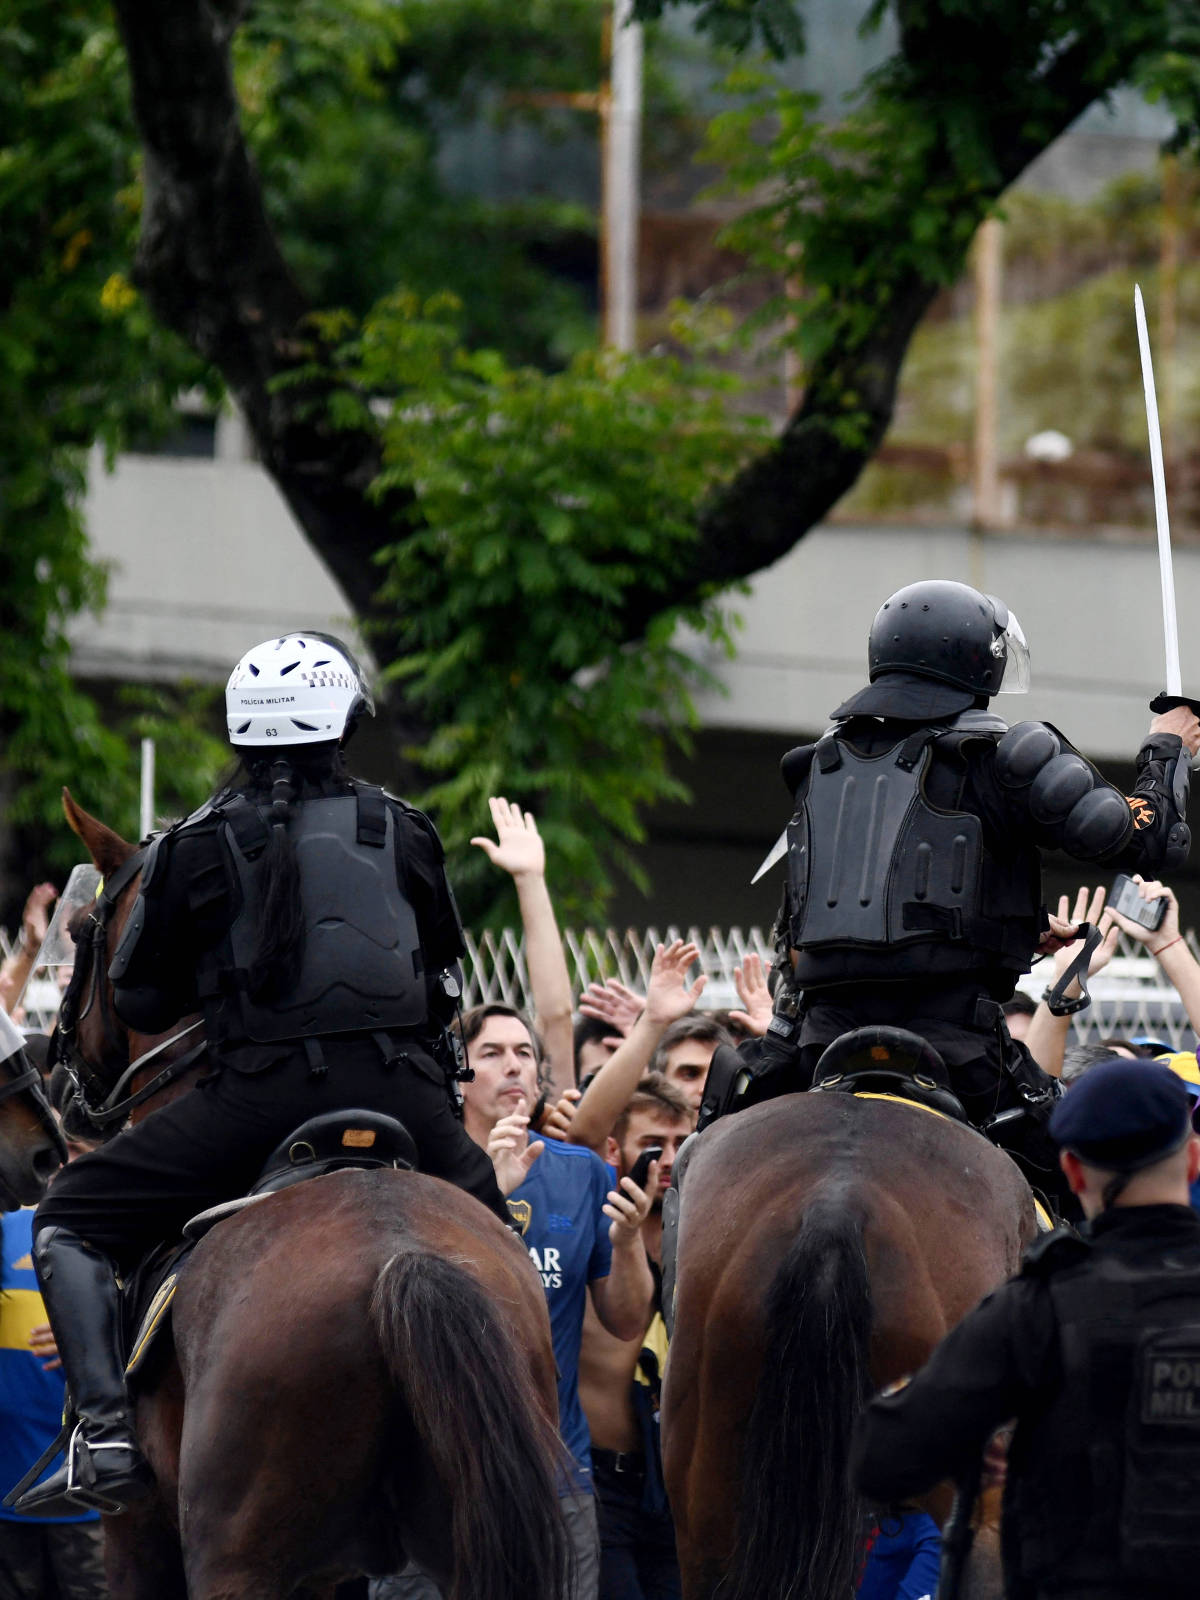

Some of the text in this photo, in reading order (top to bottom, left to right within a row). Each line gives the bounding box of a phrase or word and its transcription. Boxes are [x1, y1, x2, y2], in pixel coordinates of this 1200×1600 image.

[266, 696, 295, 704] MILITAR
[265, 728, 278, 737] 63
[541, 1273, 562, 1288] YS
